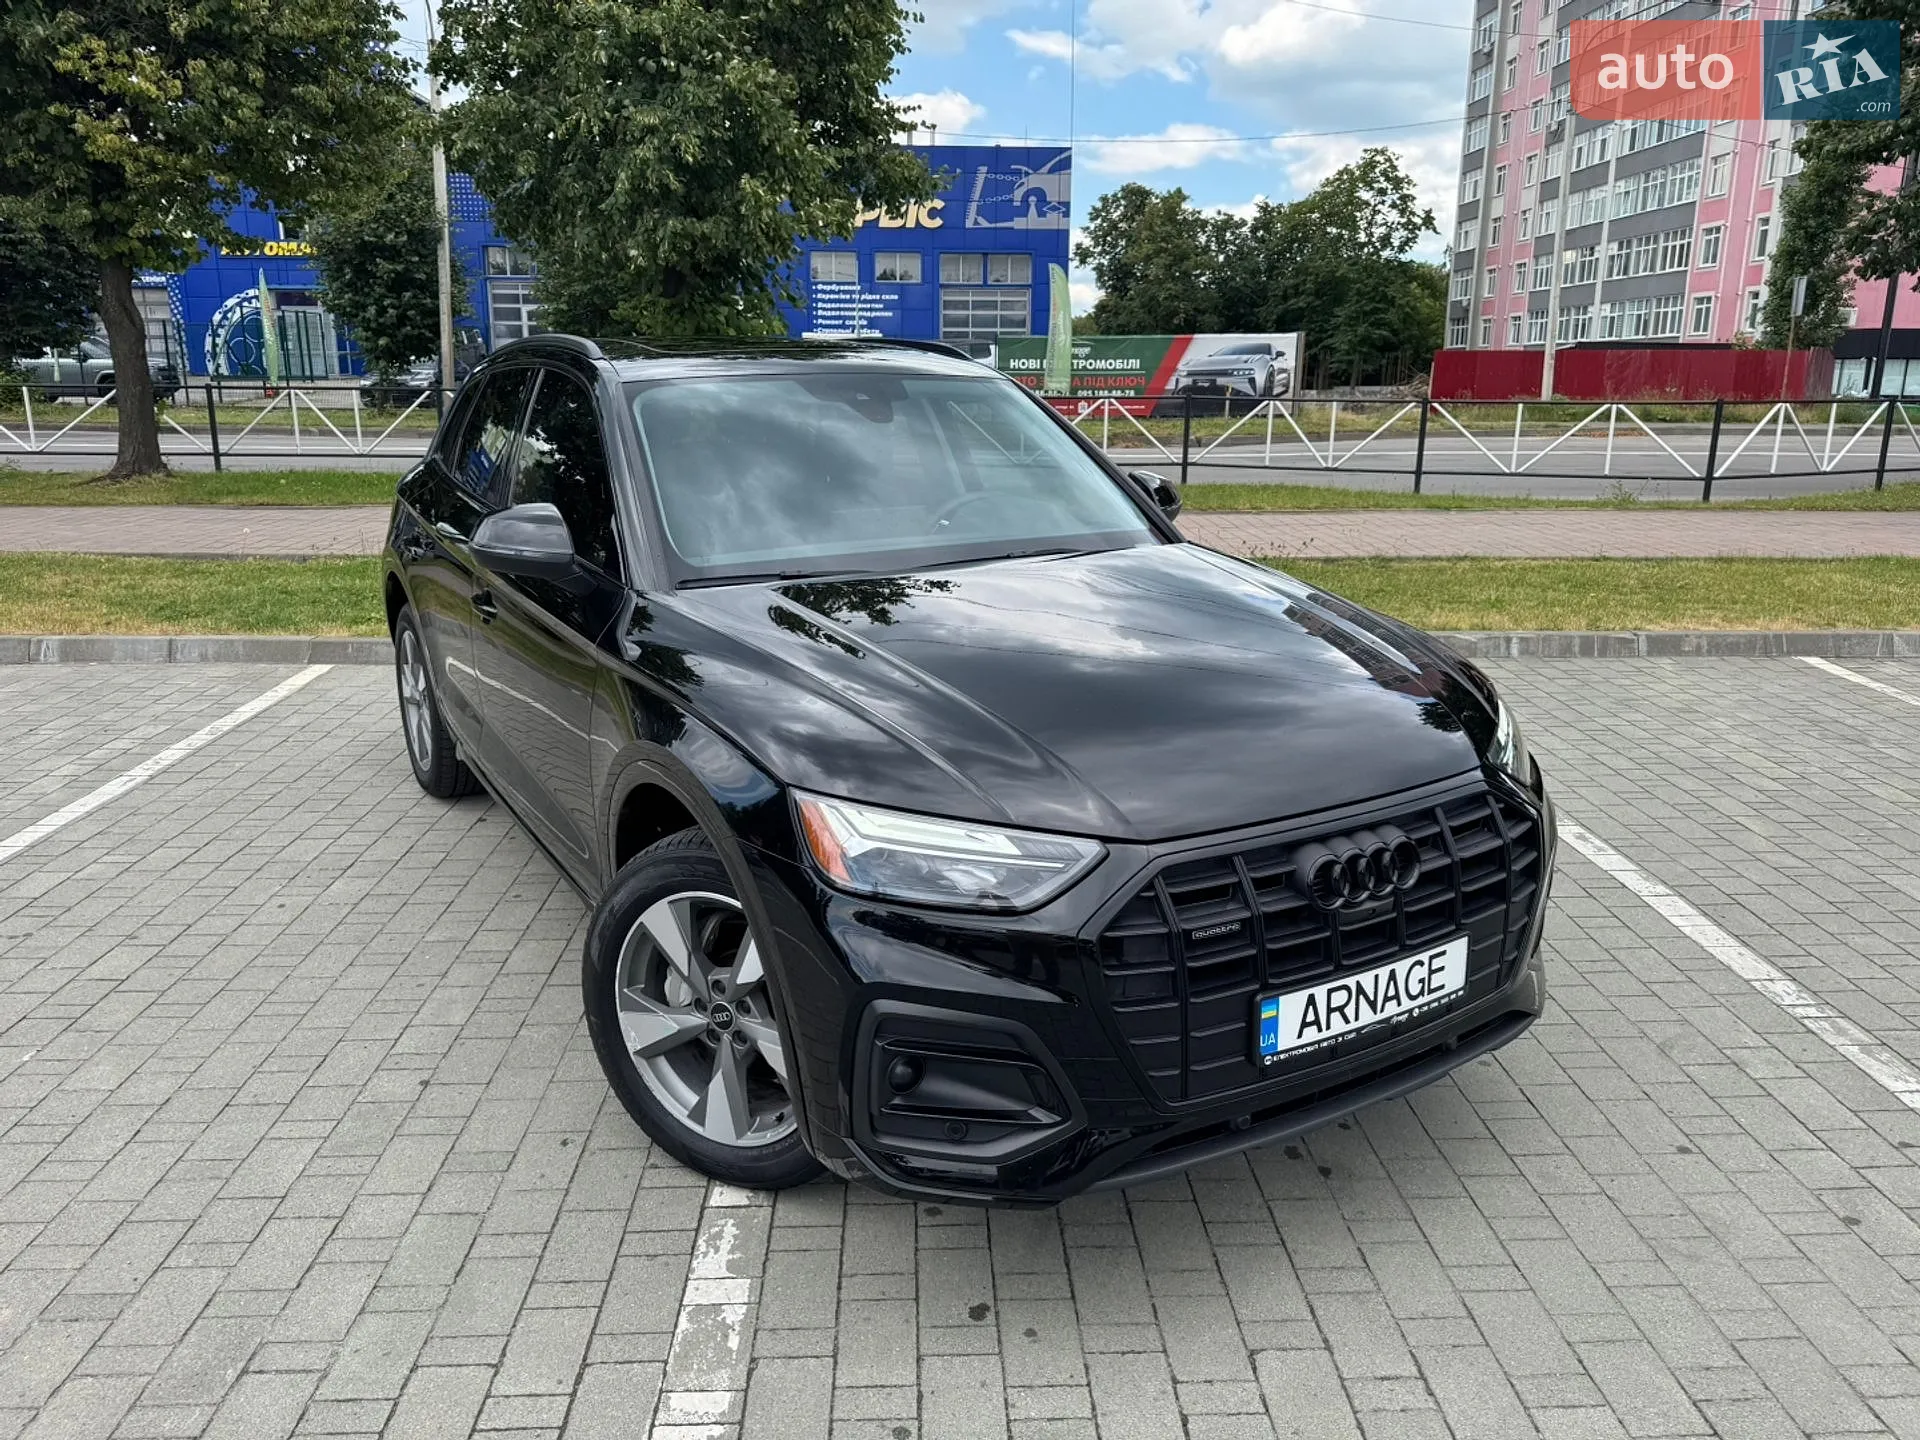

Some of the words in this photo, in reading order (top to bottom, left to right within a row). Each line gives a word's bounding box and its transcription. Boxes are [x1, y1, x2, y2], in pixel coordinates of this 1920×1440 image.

[1010, 358, 1040, 369] НОВІ
[1084, 377, 1104, 389] ПІД
[1108, 376, 1146, 388] КЛЮЧ
[1297, 950, 1447, 1039] ARNAGE
[1260, 1032, 1275, 1047] UA
